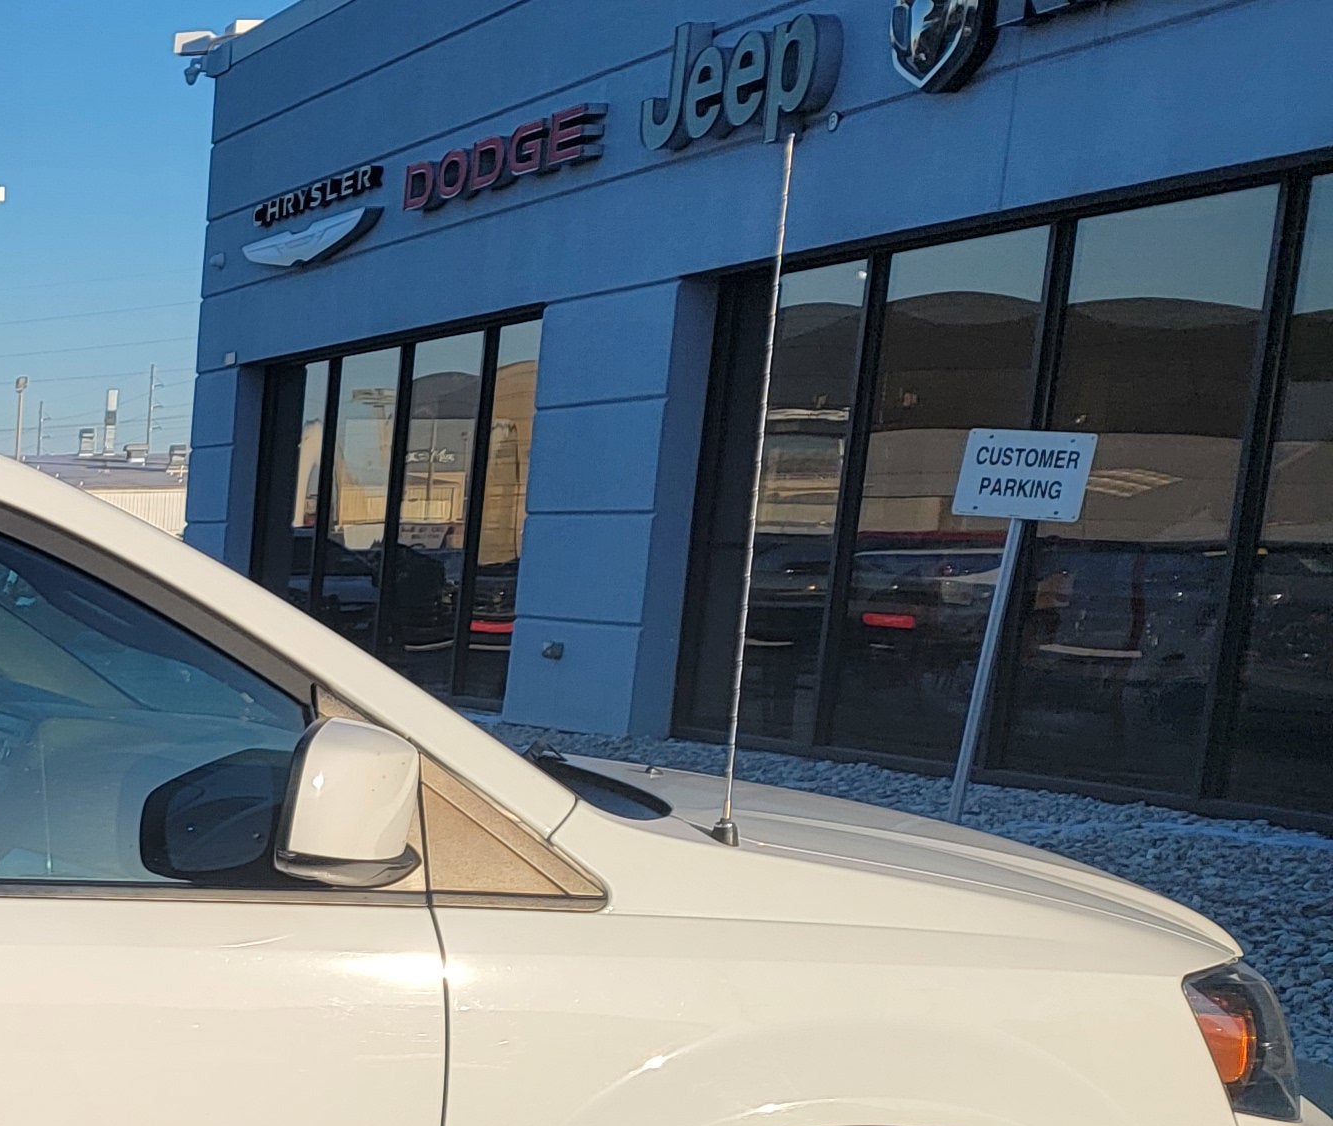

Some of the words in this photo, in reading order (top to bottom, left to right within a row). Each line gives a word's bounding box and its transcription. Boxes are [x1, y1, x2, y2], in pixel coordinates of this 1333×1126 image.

[640, 14, 817, 151] Jeep
[403, 103, 593, 211] DODGE
[252, 165, 373, 227] CHRYSLER
[976, 446, 1081, 469] CUSTOMER
[978, 477, 1062, 500] PARKING
